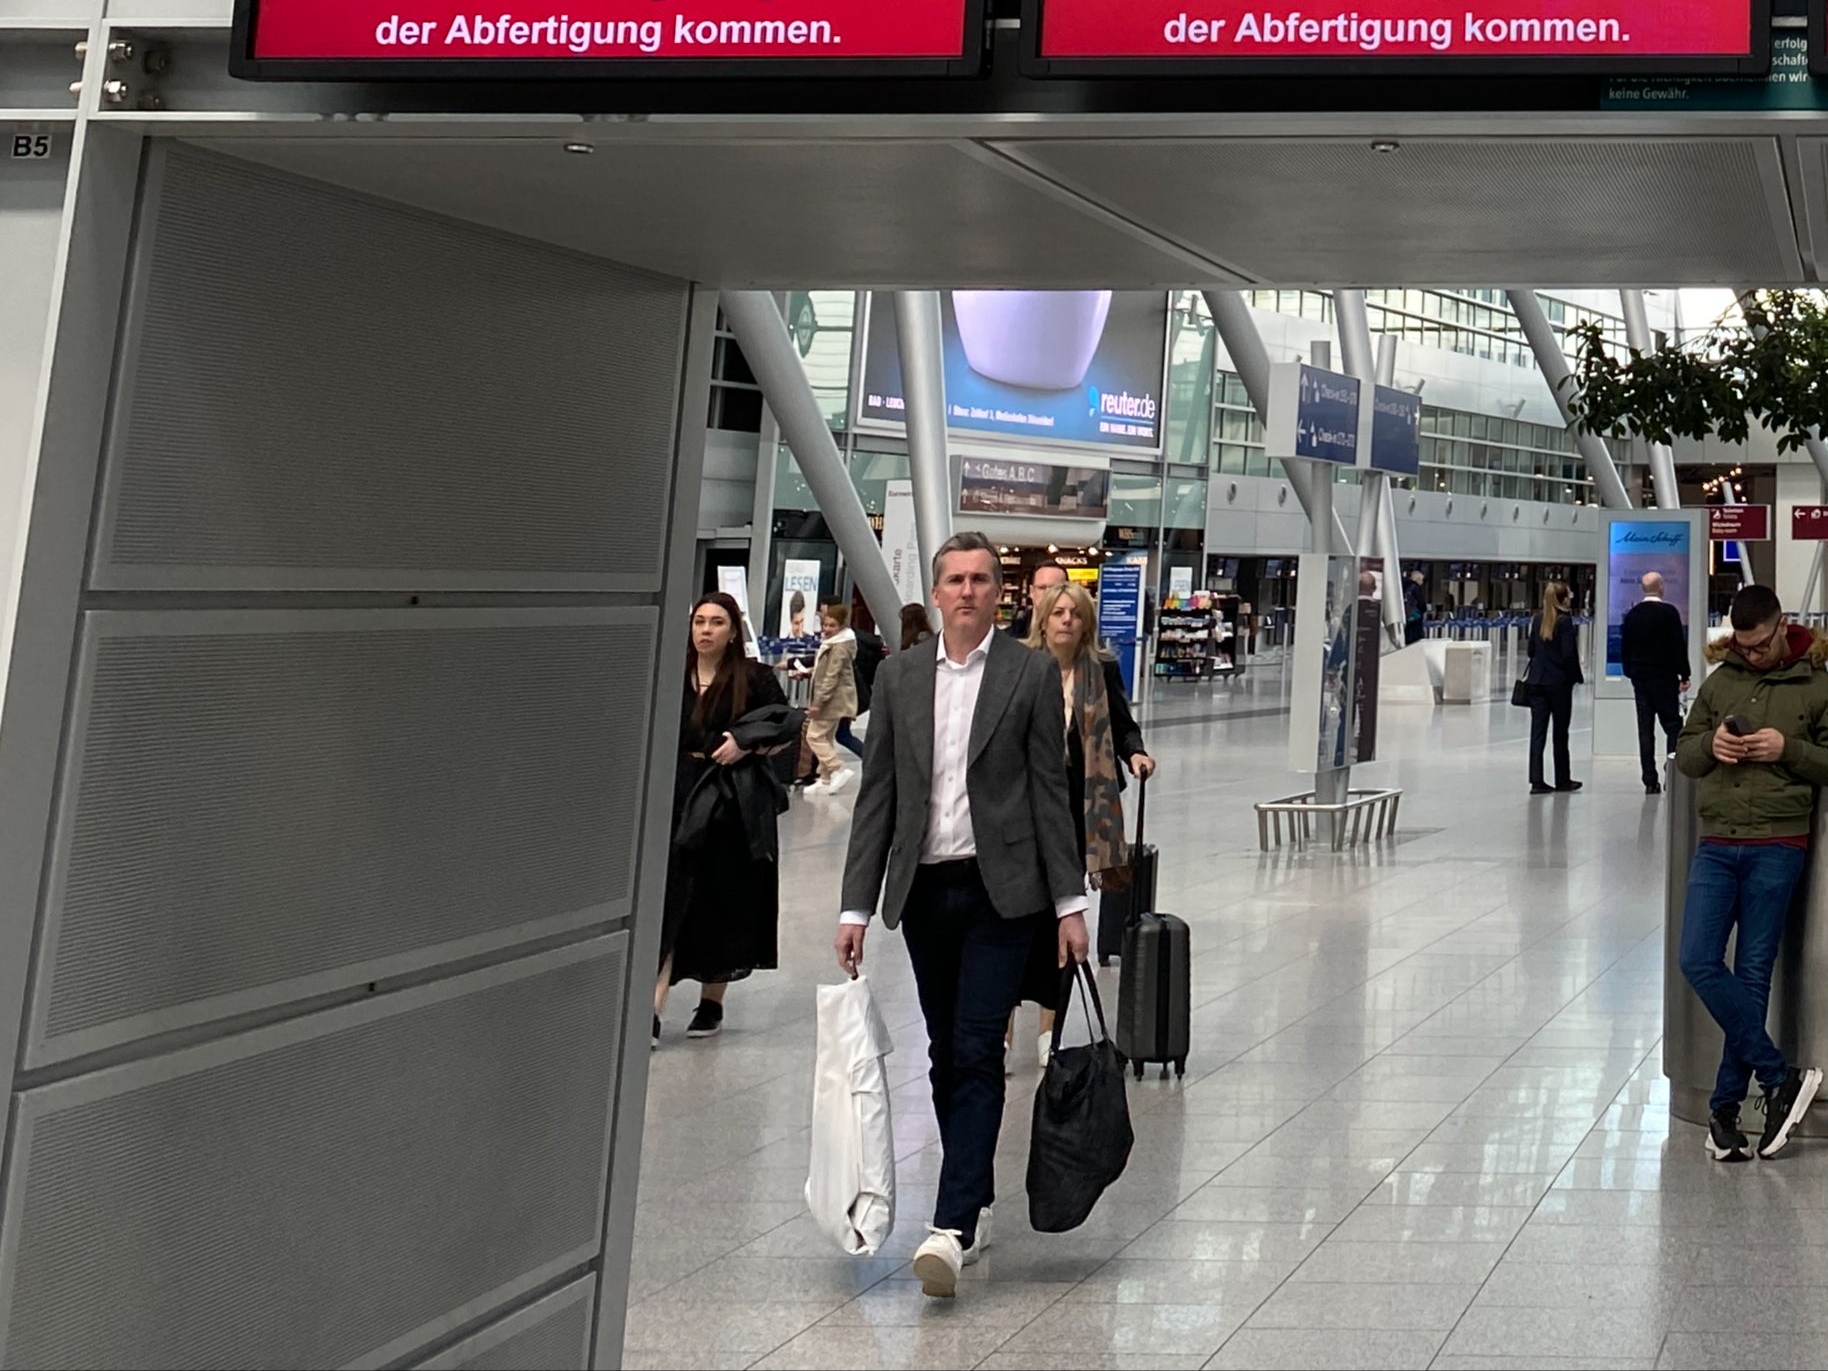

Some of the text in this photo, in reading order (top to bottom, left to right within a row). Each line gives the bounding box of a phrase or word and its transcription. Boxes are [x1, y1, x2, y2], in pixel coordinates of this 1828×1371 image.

[1608, 87, 1690, 99] keine Gewähr.
[13, 135, 49, 157] B5
[1100, 391, 1155, 419] reuter.de
[785, 576, 817, 591] LESEN
